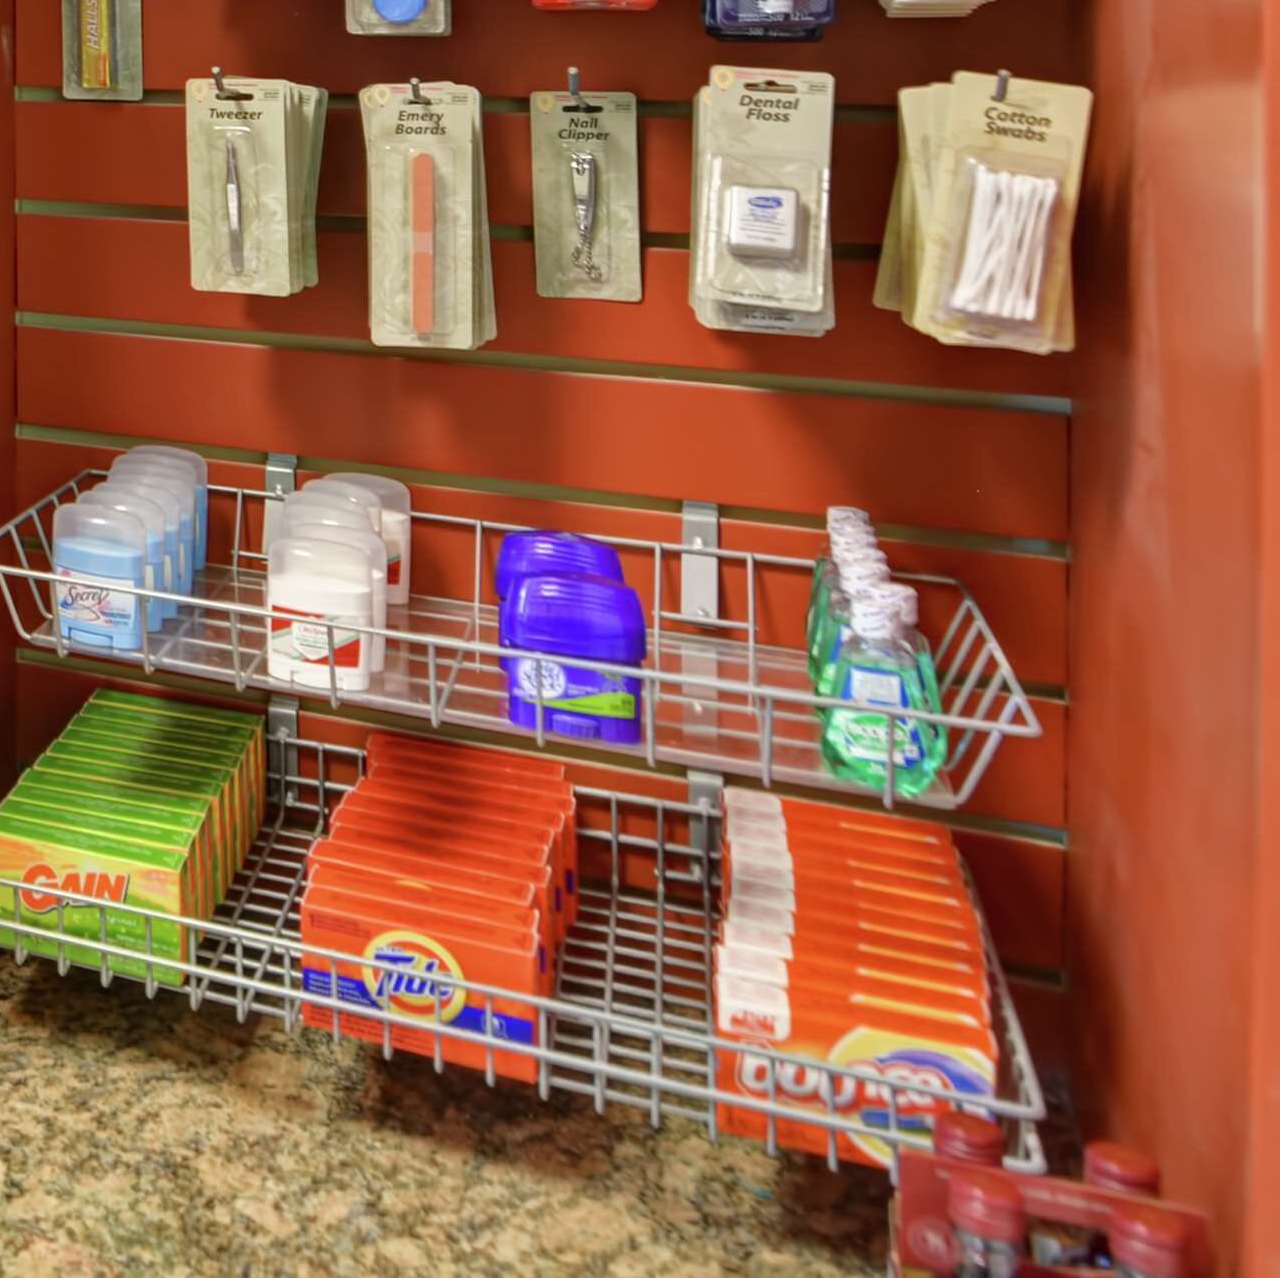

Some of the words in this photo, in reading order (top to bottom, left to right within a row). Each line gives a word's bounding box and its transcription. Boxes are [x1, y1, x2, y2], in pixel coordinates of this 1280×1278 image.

[738, 95, 801, 111] Dental
[208, 107, 264, 122] Tweezer
[397, 109, 445, 125] Emery
[745, 107, 792, 123] Floss
[983, 106, 1054, 129] Cotton
[394, 123, 448, 137] Boards
[568, 116, 599, 130] Nail
[558, 128, 610, 143] Clipper
[983, 121, 1048, 143] Swabs
[60, 585, 110, 608] Secret
[373, 951, 457, 1000] Tide
